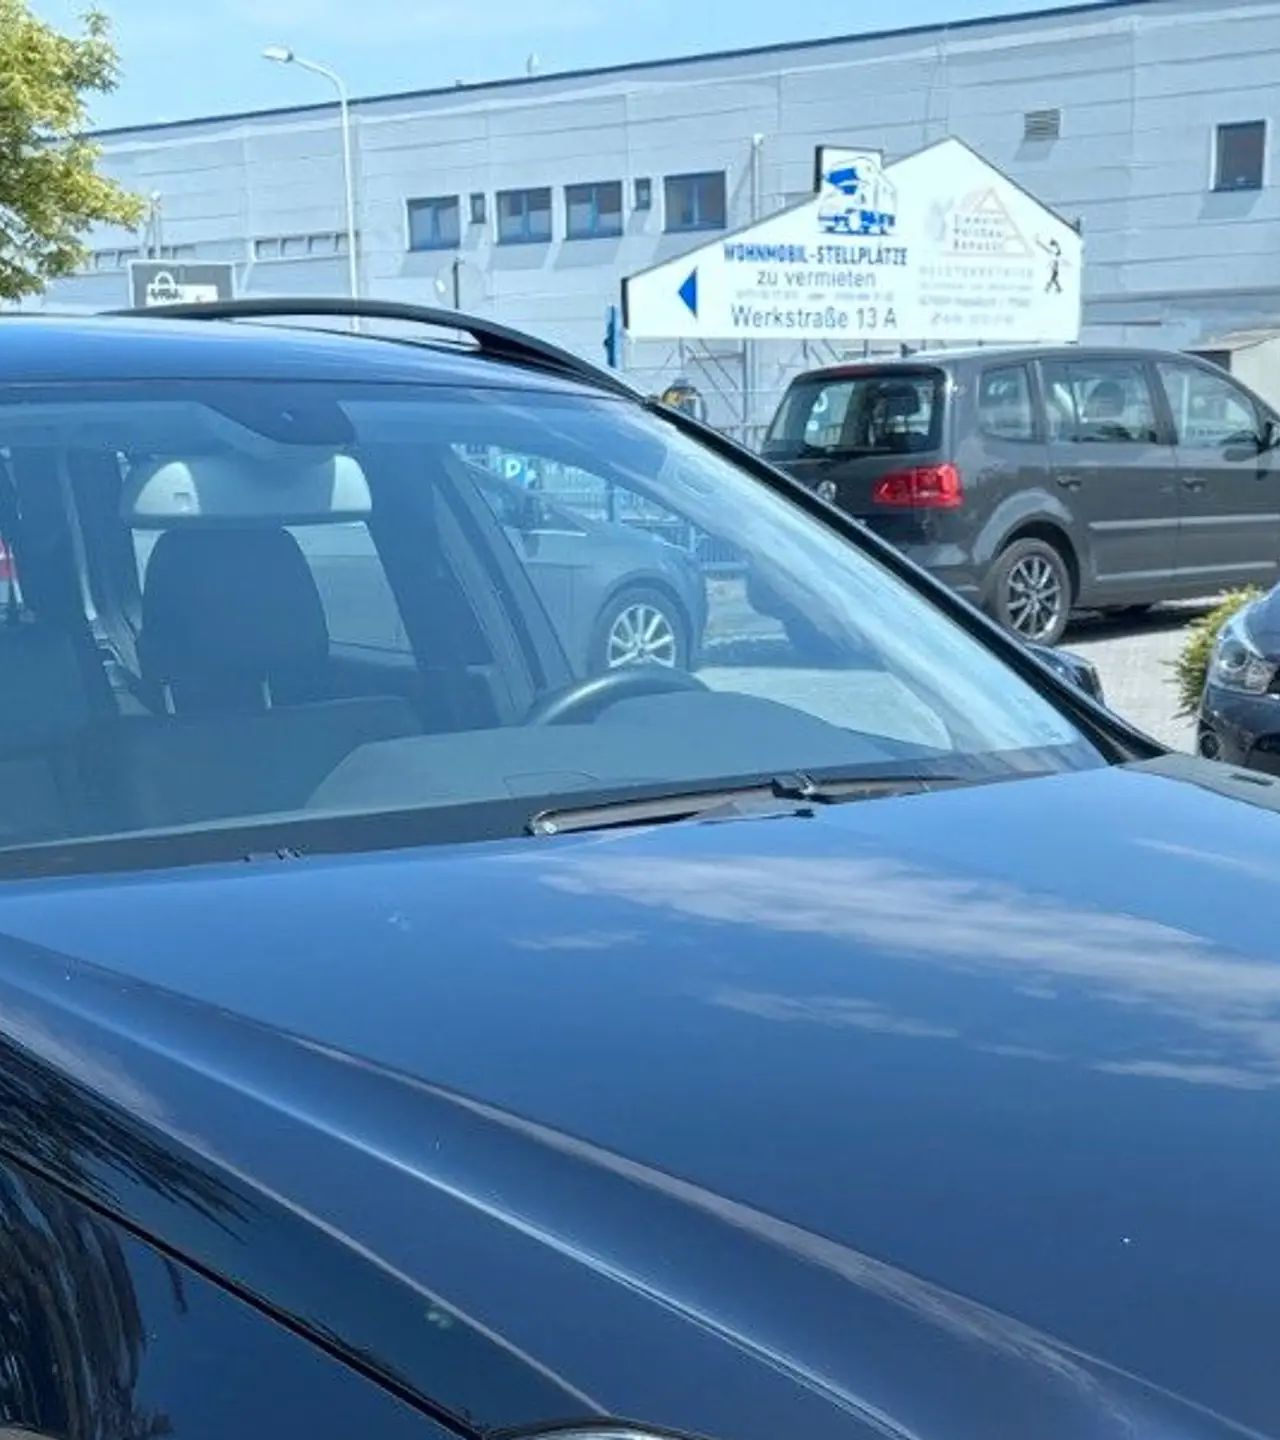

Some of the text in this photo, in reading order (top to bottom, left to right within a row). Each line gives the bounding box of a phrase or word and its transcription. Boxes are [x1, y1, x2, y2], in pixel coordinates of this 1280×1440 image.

[724, 241, 908, 266] WOHNMOBIL-STELLPLÄTZE
[757, 270, 877, 288] zu vermieten
[731, 304, 898, 330] Werkstraße 13 A
